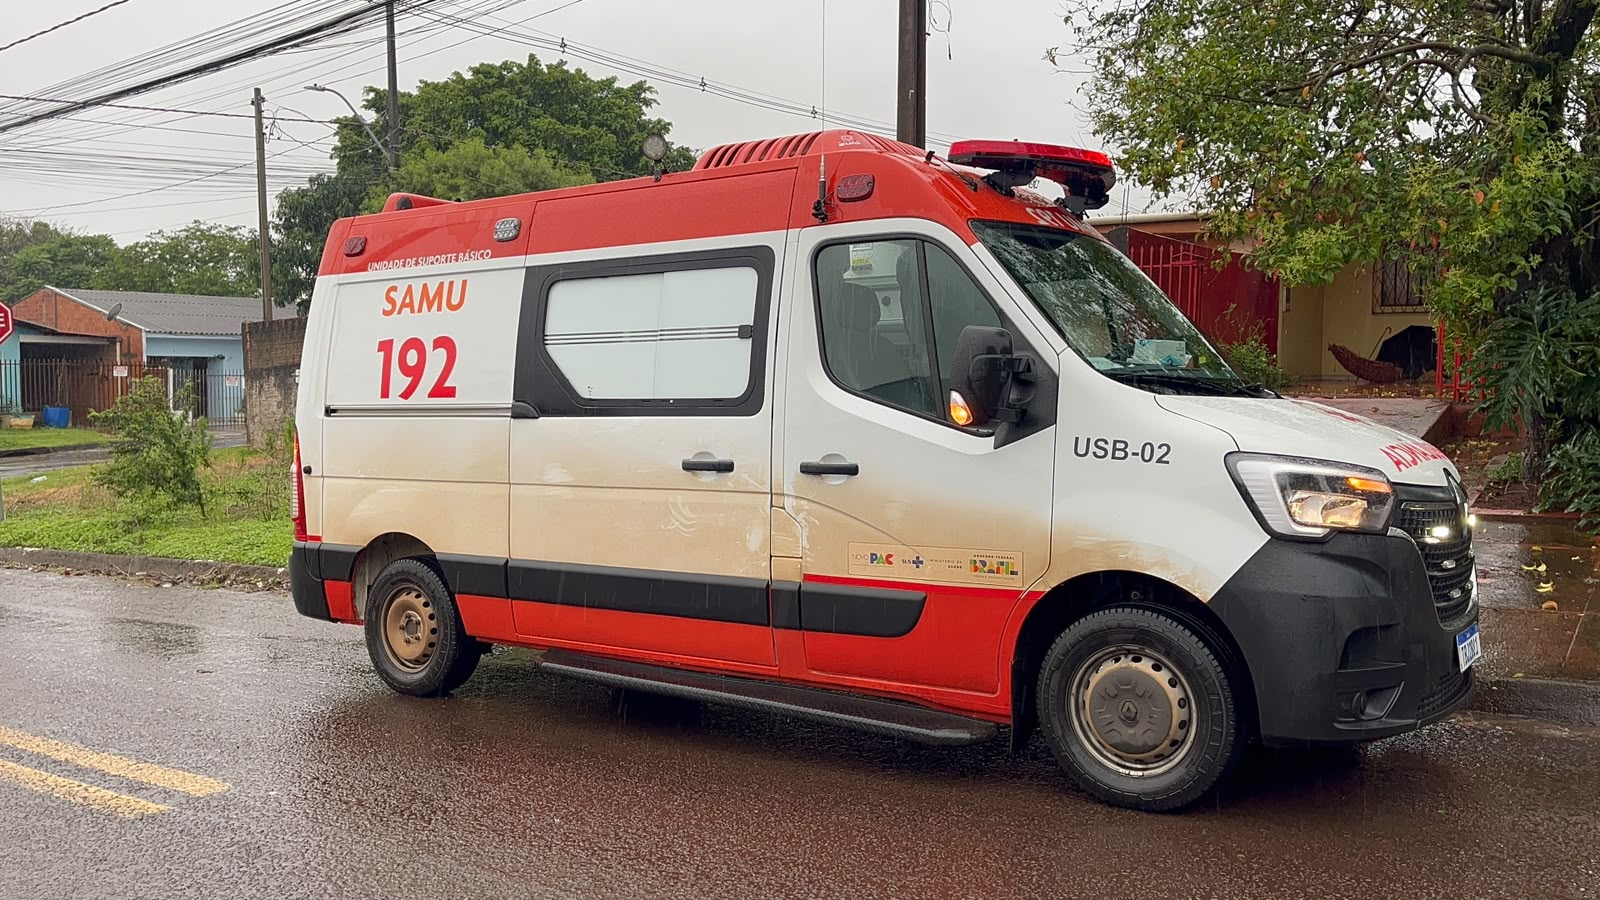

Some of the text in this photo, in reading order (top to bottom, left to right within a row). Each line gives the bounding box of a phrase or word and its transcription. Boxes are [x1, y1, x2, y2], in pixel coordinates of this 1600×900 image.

[367, 249, 492, 272] UNIDADE DE SUPORTE BÁSICO
[382, 279, 468, 317] SAMU
[377, 335, 457, 401] 192
[1073, 436, 1171, 465] USB-02
[851, 552, 895, 566] NOVO PAC
[969, 559, 1019, 576] BRASIL
